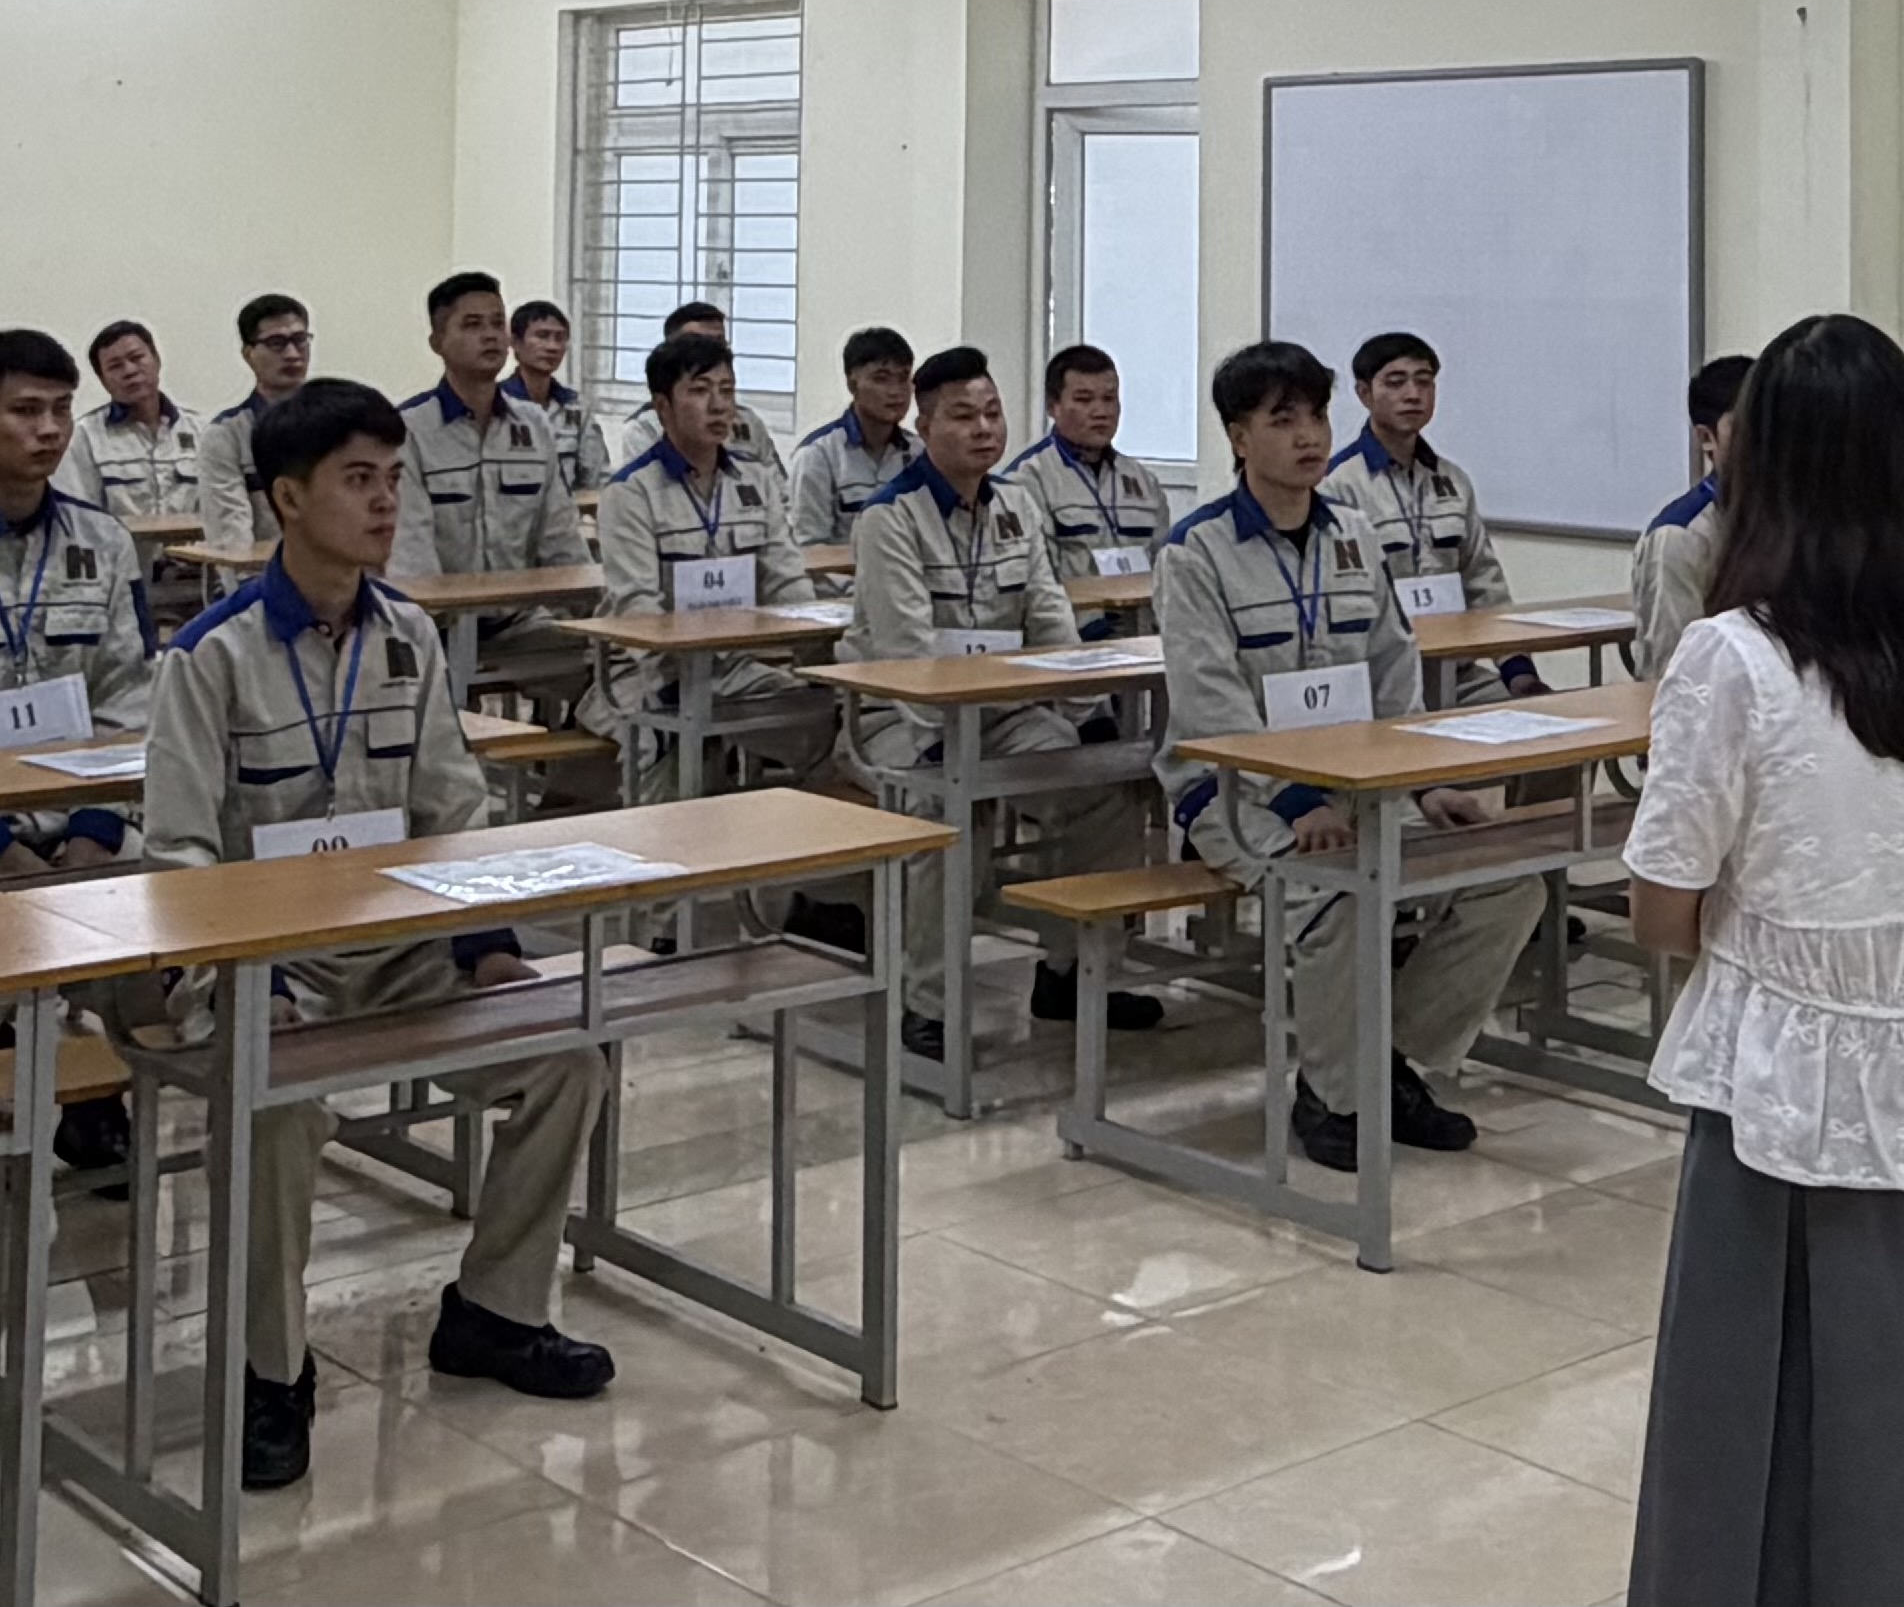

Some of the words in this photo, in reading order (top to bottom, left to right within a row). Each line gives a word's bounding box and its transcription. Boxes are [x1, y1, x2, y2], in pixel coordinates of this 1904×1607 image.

[1411, 587, 1434, 608] 13
[1303, 683, 1331, 710] 07
[11, 702, 36, 730] 11
